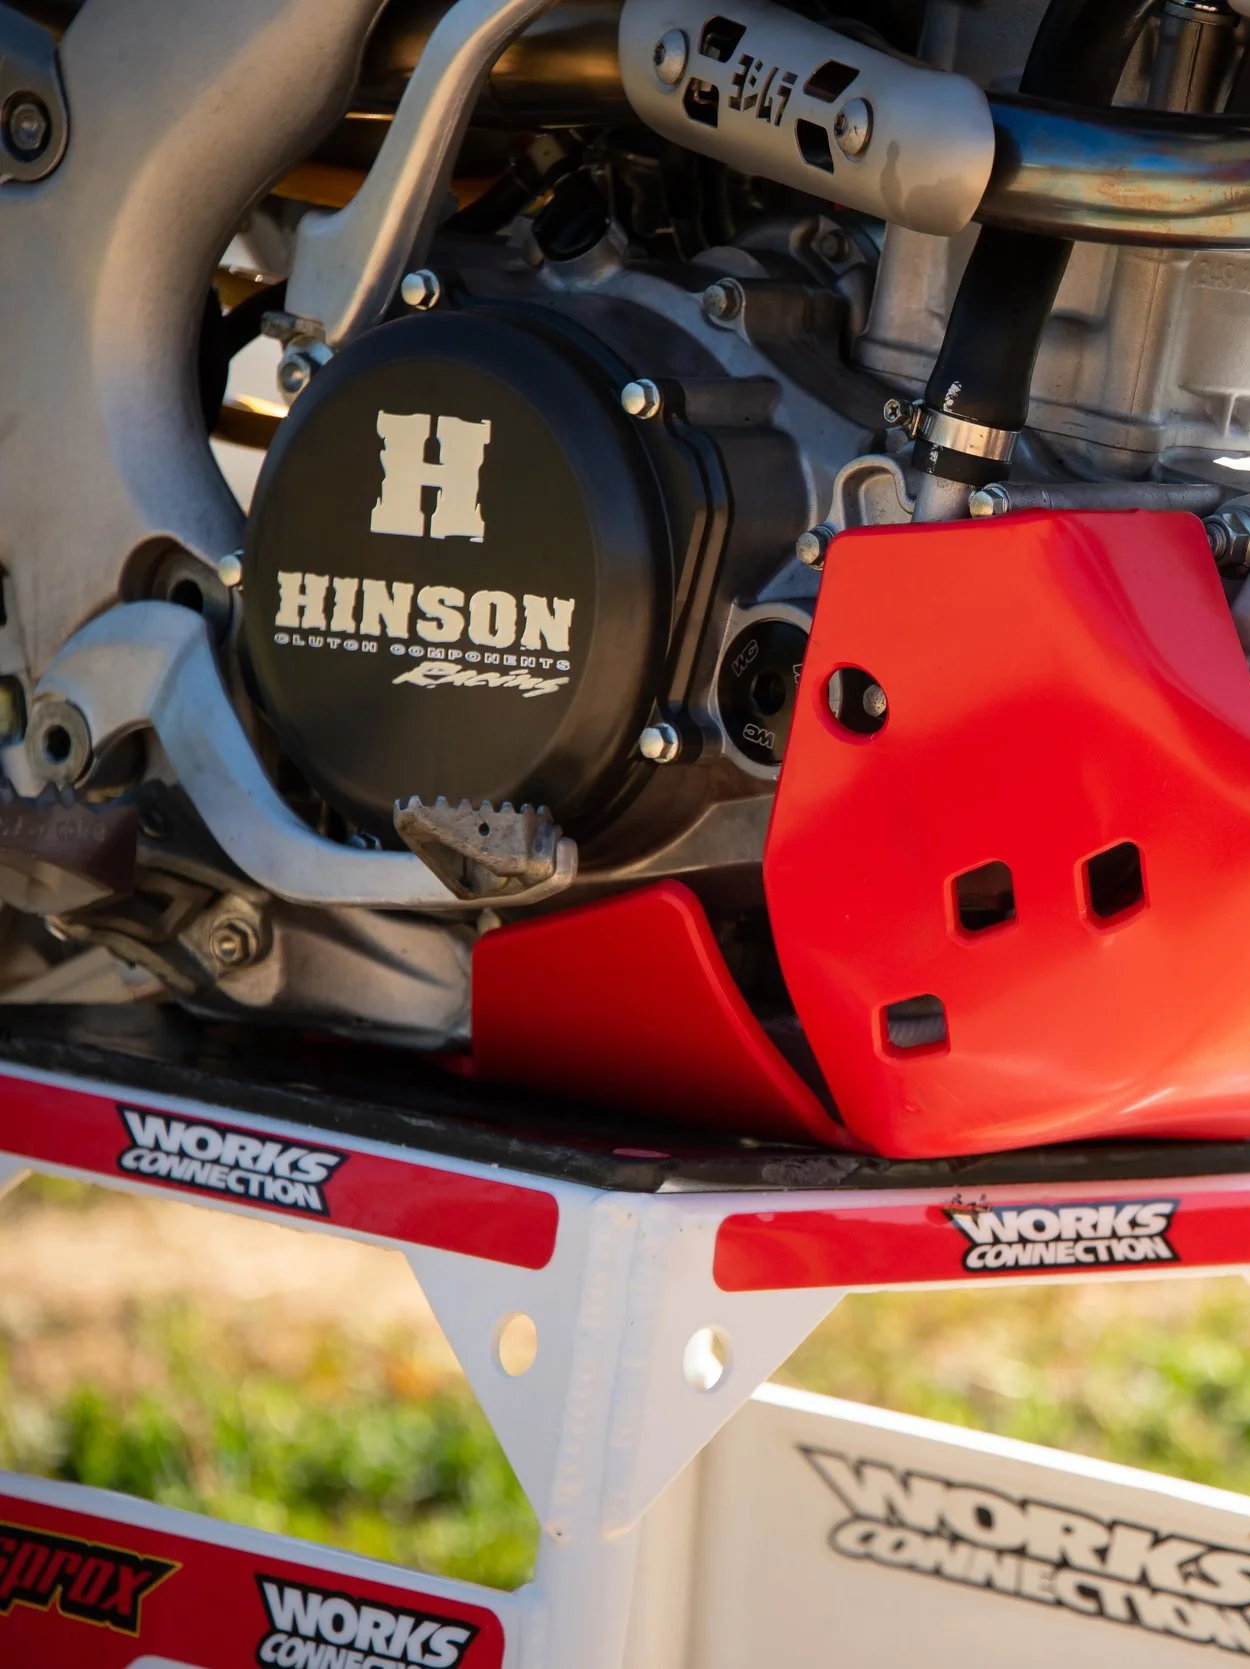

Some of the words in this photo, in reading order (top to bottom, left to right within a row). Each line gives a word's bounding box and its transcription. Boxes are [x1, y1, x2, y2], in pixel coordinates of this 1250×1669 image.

[370, 409, 491, 543] H
[275, 570, 575, 652] HINSON
[274, 633, 377, 653] CLUTCH
[390, 644, 571, 671] COMPONENTS
[120, 1149, 323, 1211] CONNECTION
[123, 1109, 341, 1184] WORKS
[953, 1202, 1175, 1244] WORKS
[965, 1236, 1173, 1269] CONNECTION
[262, 1581, 472, 1669] WORKS
